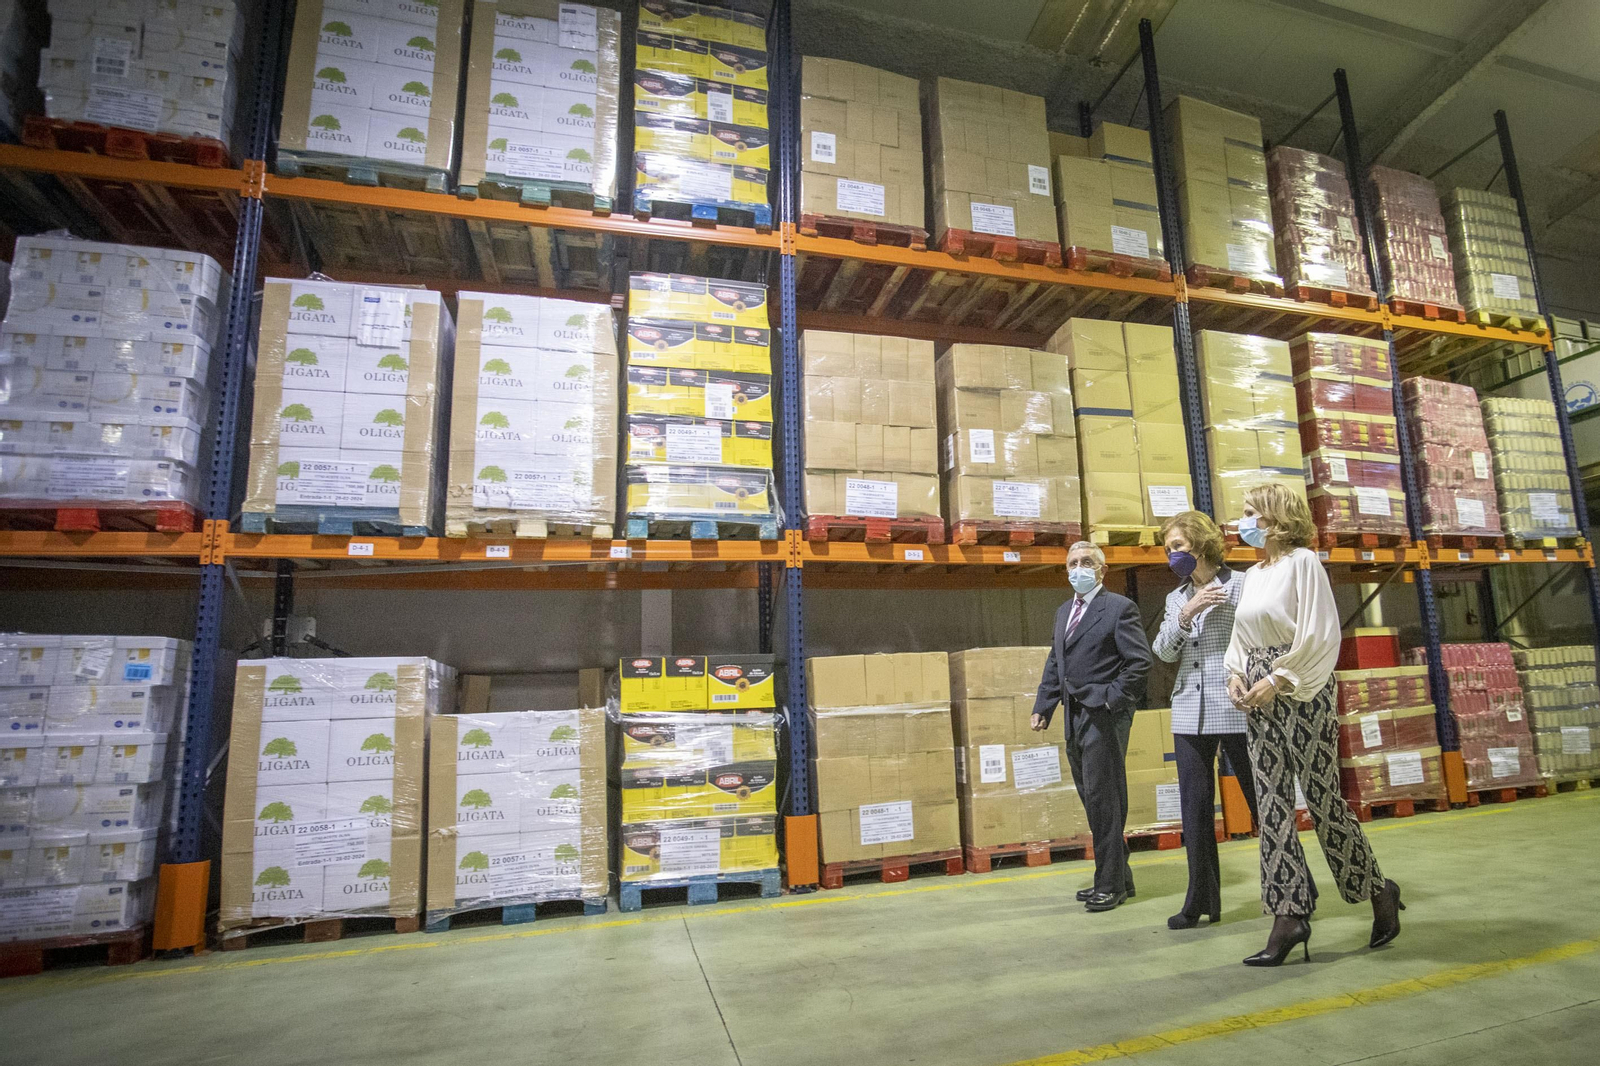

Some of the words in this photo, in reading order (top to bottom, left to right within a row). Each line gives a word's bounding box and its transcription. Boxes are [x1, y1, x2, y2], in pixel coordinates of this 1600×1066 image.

[399, 3, 438, 17] OLIGA
[496, 18, 536, 32] LIGATA
[319, 34, 364, 50] LIGATA
[394, 48, 435, 62] OLIGA
[492, 62, 533, 75] LIGATA
[560, 71, 598, 84] OLIGAT
[313, 81, 358, 96] LIGATA
[389, 93, 432, 108] OLIGAT
[488, 107, 530, 120] LIGATA
[557, 116, 597, 130] OLIGAT
[307, 129, 352, 144] LIGATA
[720, 131, 740, 141] ABRIL
[384, 140, 427, 154] OLIGA
[564, 162, 594, 174] LIGA
[717, 292, 739, 300] ABRIL
[288, 311, 336, 324] LIGATA
[482, 322, 525, 336] LIGATA
[554, 329, 590, 341] OLIGA
[638, 330, 661, 339] ABRIL
[284, 366, 330, 379] LIGATA
[364, 371, 408, 383] OLIGA
[480, 376, 524, 388] LIGATA
[279, 423, 326, 435] LIGATA
[360, 427, 404, 439] OLIGA
[477, 430, 522, 442] LIGATA
[552, 433, 591, 444] OLIGA
[366, 483, 401, 494] LIGA
[719, 668, 742, 678] ABRIL
[264, 696, 316, 708] LIGATA
[350, 694, 396, 705] OLIGA
[458, 749, 505, 761] LIGATA
[537, 746, 581, 757] OLIGAT
[258, 759, 311, 772] LIGATA
[346, 755, 395, 767] OLIGAT
[719, 777, 742, 786] ABRIL
[457, 810, 505, 822] LIGATA
[254, 823, 296, 837] LIGAT
[299, 826, 308, 834] 22
[310, 824, 335, 832] 0058-1
[502, 855, 526, 863] 0057-1
[456, 873, 489, 886] LIGA
[343, 882, 390, 895] OLIGA
[251, 889, 305, 903] LIGATA
